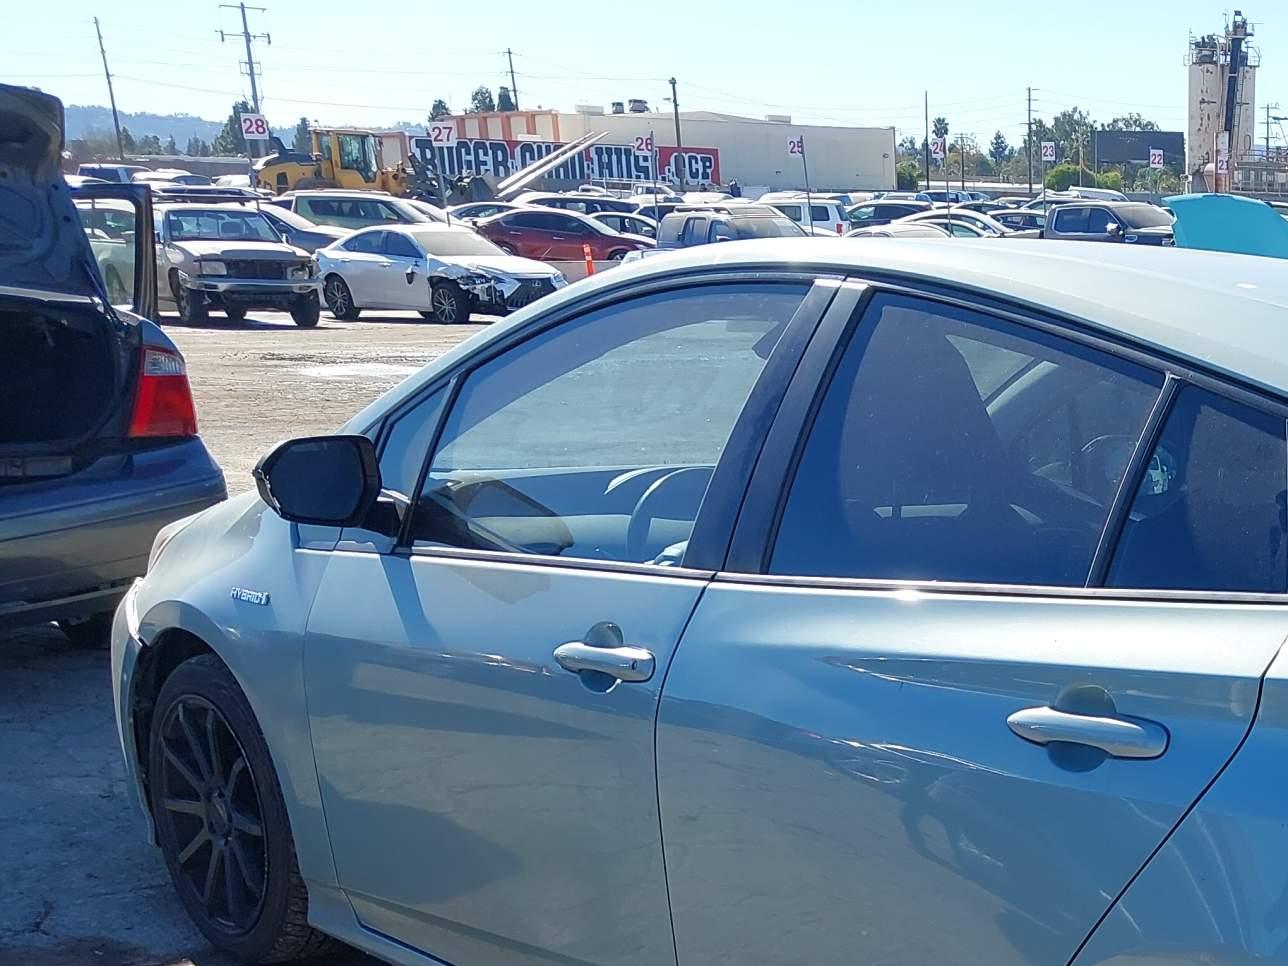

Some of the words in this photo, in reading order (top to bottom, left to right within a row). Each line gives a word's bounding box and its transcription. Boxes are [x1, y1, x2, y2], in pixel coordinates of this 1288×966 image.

[243, 118, 266, 135] 28
[431, 126, 453, 142] 27
[635, 136, 653, 152] 26
[788, 140, 802, 155] 25
[1042, 145, 1055, 158] 23
[1151, 153, 1163, 165] 22
[1218, 159, 1229, 171] 21
